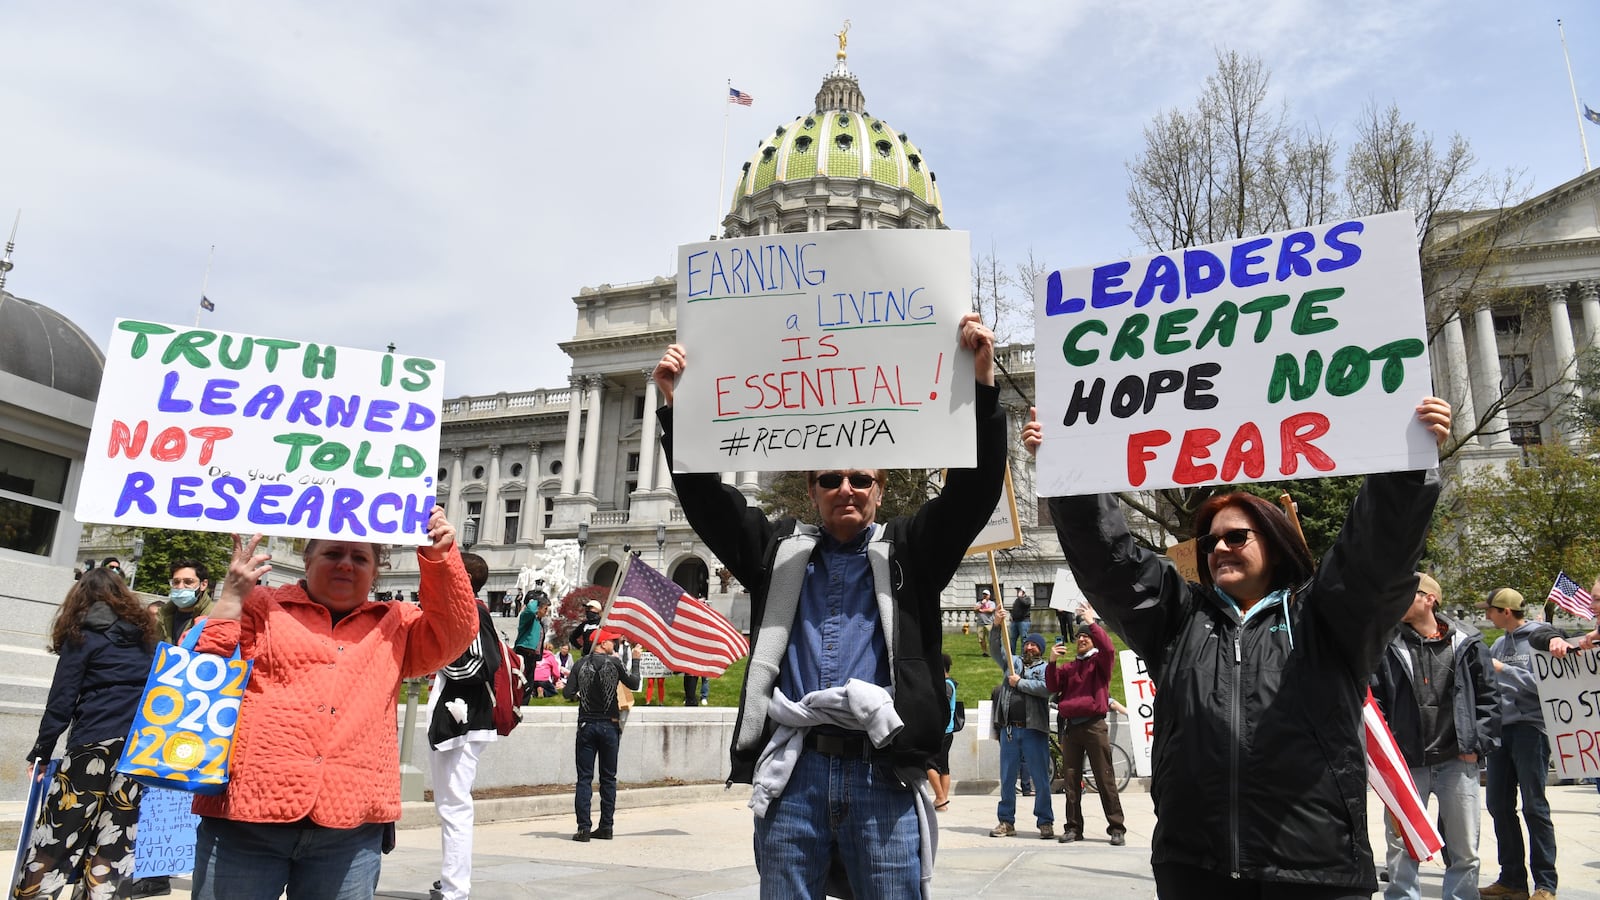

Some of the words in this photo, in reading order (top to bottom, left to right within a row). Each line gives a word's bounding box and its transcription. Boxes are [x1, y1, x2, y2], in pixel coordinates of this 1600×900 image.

[688, 243, 825, 296] EARNING
[1046, 221, 1364, 316] LEADERS
[786, 313, 800, 331] a
[818, 287, 933, 327] LIVING
[1062, 287, 1345, 367] CREATE
[118, 320, 336, 379] TRUTH
[381, 354, 436, 392] IS
[781, 335, 839, 362] IS
[158, 370, 436, 433] LEARNED
[1063, 362, 1222, 426] HOPE
[1267, 338, 1425, 404] NOT
[107, 419, 233, 466] NOT
[719, 418, 895, 457] #REOPENPA
[1127, 411, 1337, 488] FEAR
[208, 465, 231, 478] Do
[248, 468, 286, 483] your
[299, 473, 336, 486] own
[114, 471, 435, 536] RESEARCH
[1544, 698, 1573, 724] TO
[135, 844, 194, 859] EGULAT
[137, 834, 172, 846] ATTA
